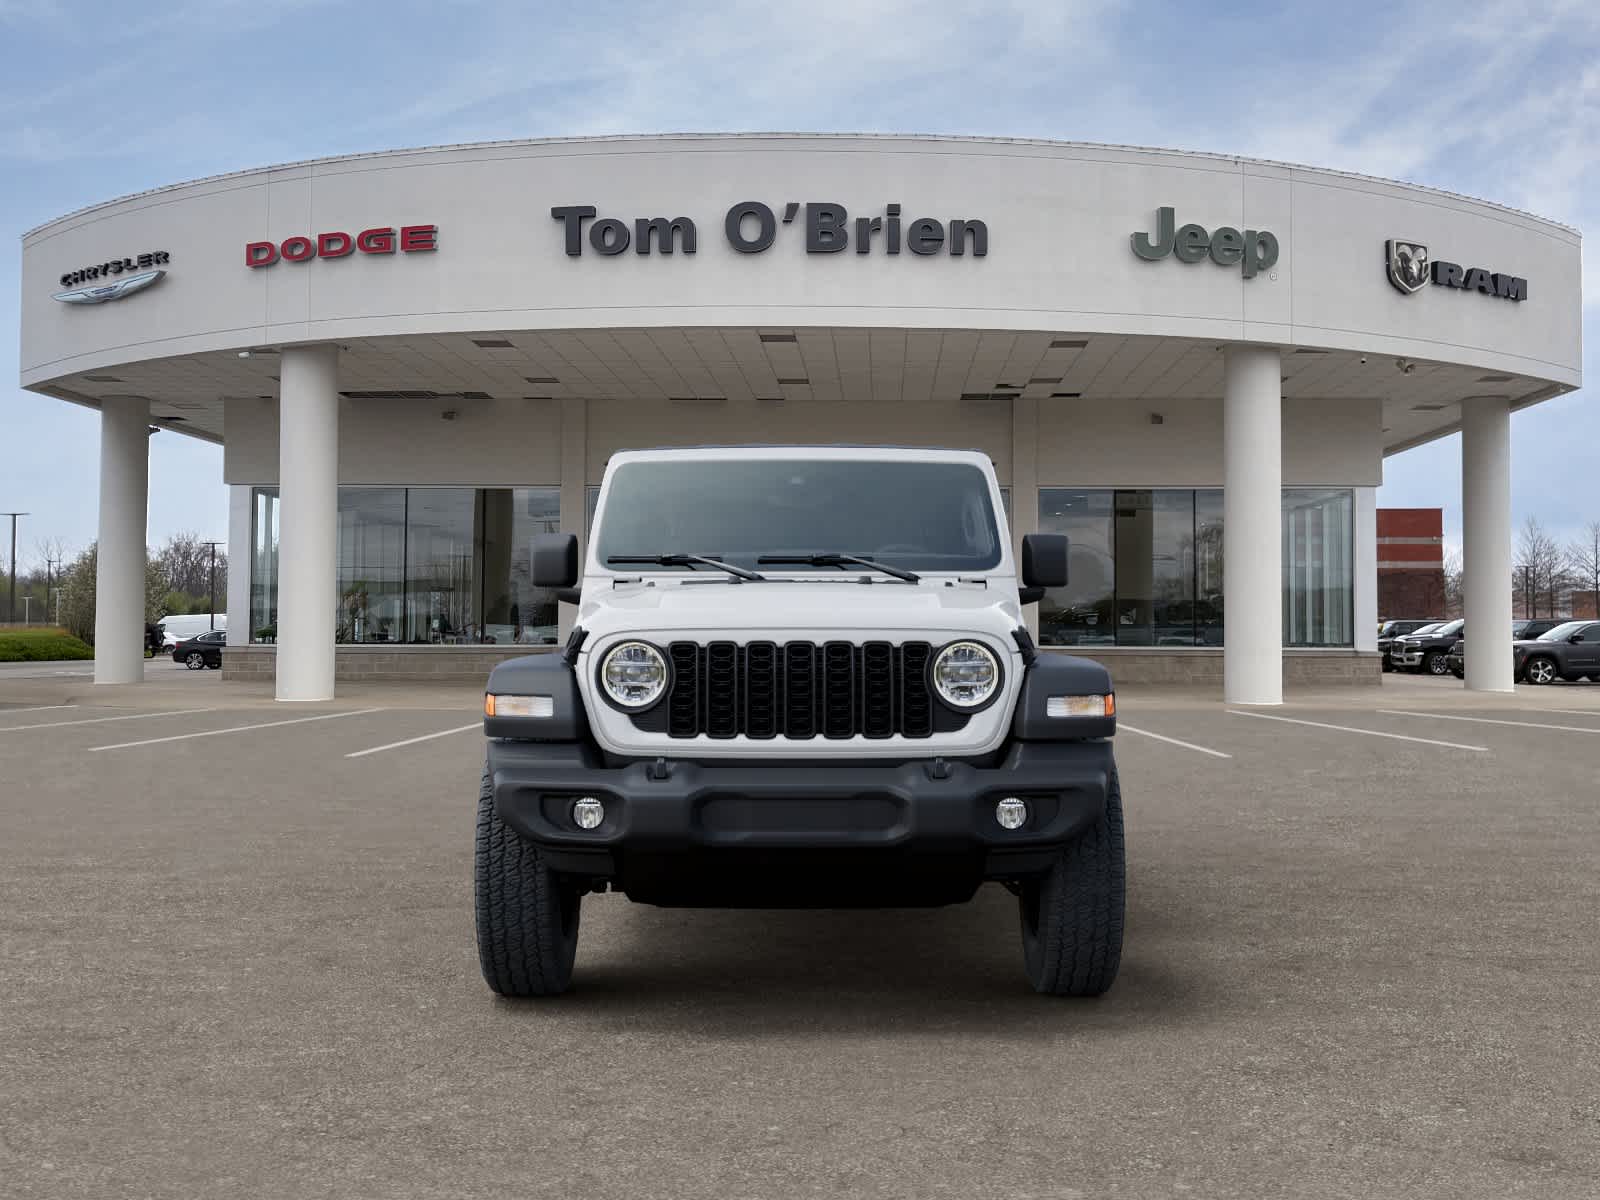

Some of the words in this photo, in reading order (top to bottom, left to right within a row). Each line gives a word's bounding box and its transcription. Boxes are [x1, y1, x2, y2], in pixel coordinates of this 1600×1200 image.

[245, 224, 438, 268] DODGE
[551, 205, 697, 256] Tom
[725, 201, 988, 256] O'Brien
[1130, 206, 1279, 279] Jeep
[60, 250, 170, 287] CHRYSLER
[1431, 260, 1528, 301] RAM
